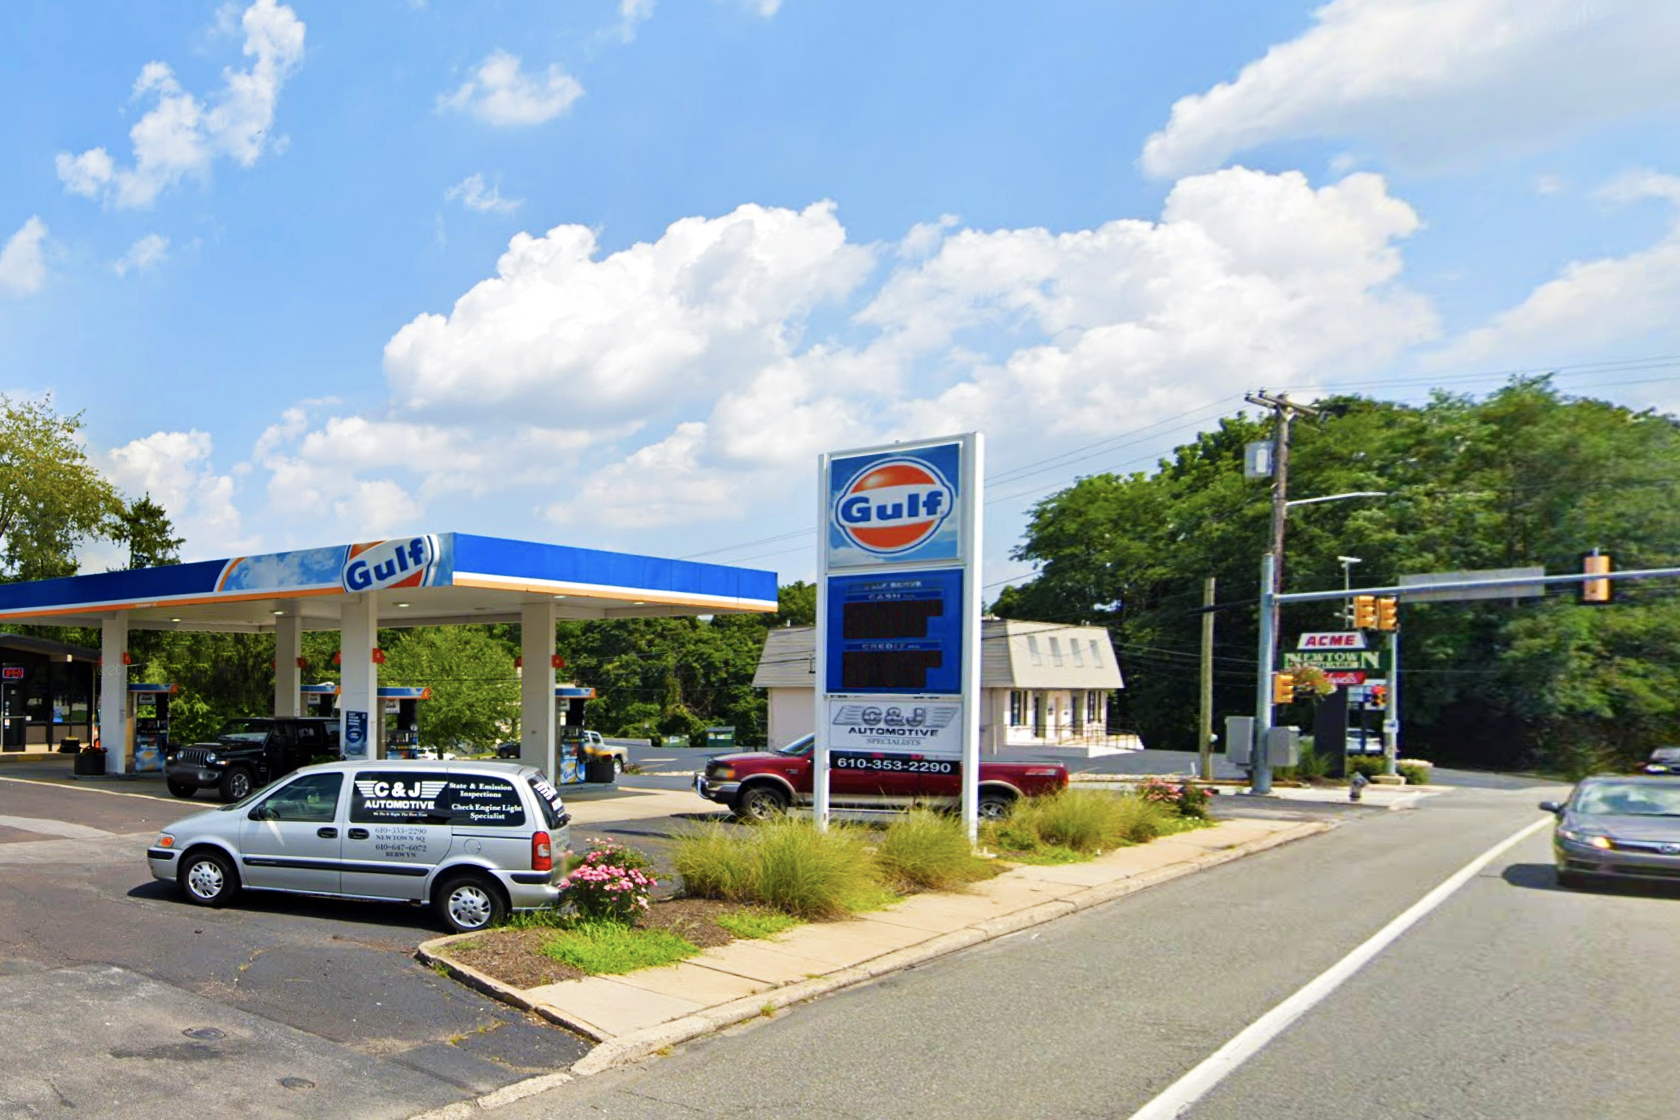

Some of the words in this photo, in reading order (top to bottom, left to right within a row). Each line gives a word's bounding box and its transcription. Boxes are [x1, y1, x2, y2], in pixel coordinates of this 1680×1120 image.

[840, 490, 944, 523] Gulf
[346, 537, 424, 590] Gulf
[1305, 635, 1356, 647] ACME
[1283, 651, 1380, 669] NEWTOWN
[848, 727, 939, 737] AUTOMOTIVE
[866, 738, 921, 746] SPECIALISTS
[837, 758, 951, 773] 610-353-2290
[479, 783, 512, 791] Emission
[460, 790, 502, 799] Inspections
[364, 800, 435, 810] AUTOMOTIVE
[451, 803, 474, 811] Check
[475, 804, 501, 812] Engine
[502, 804, 522, 814] Light
[471, 812, 505, 820] Specialist
[375, 844, 427, 852] 610-647-6072
